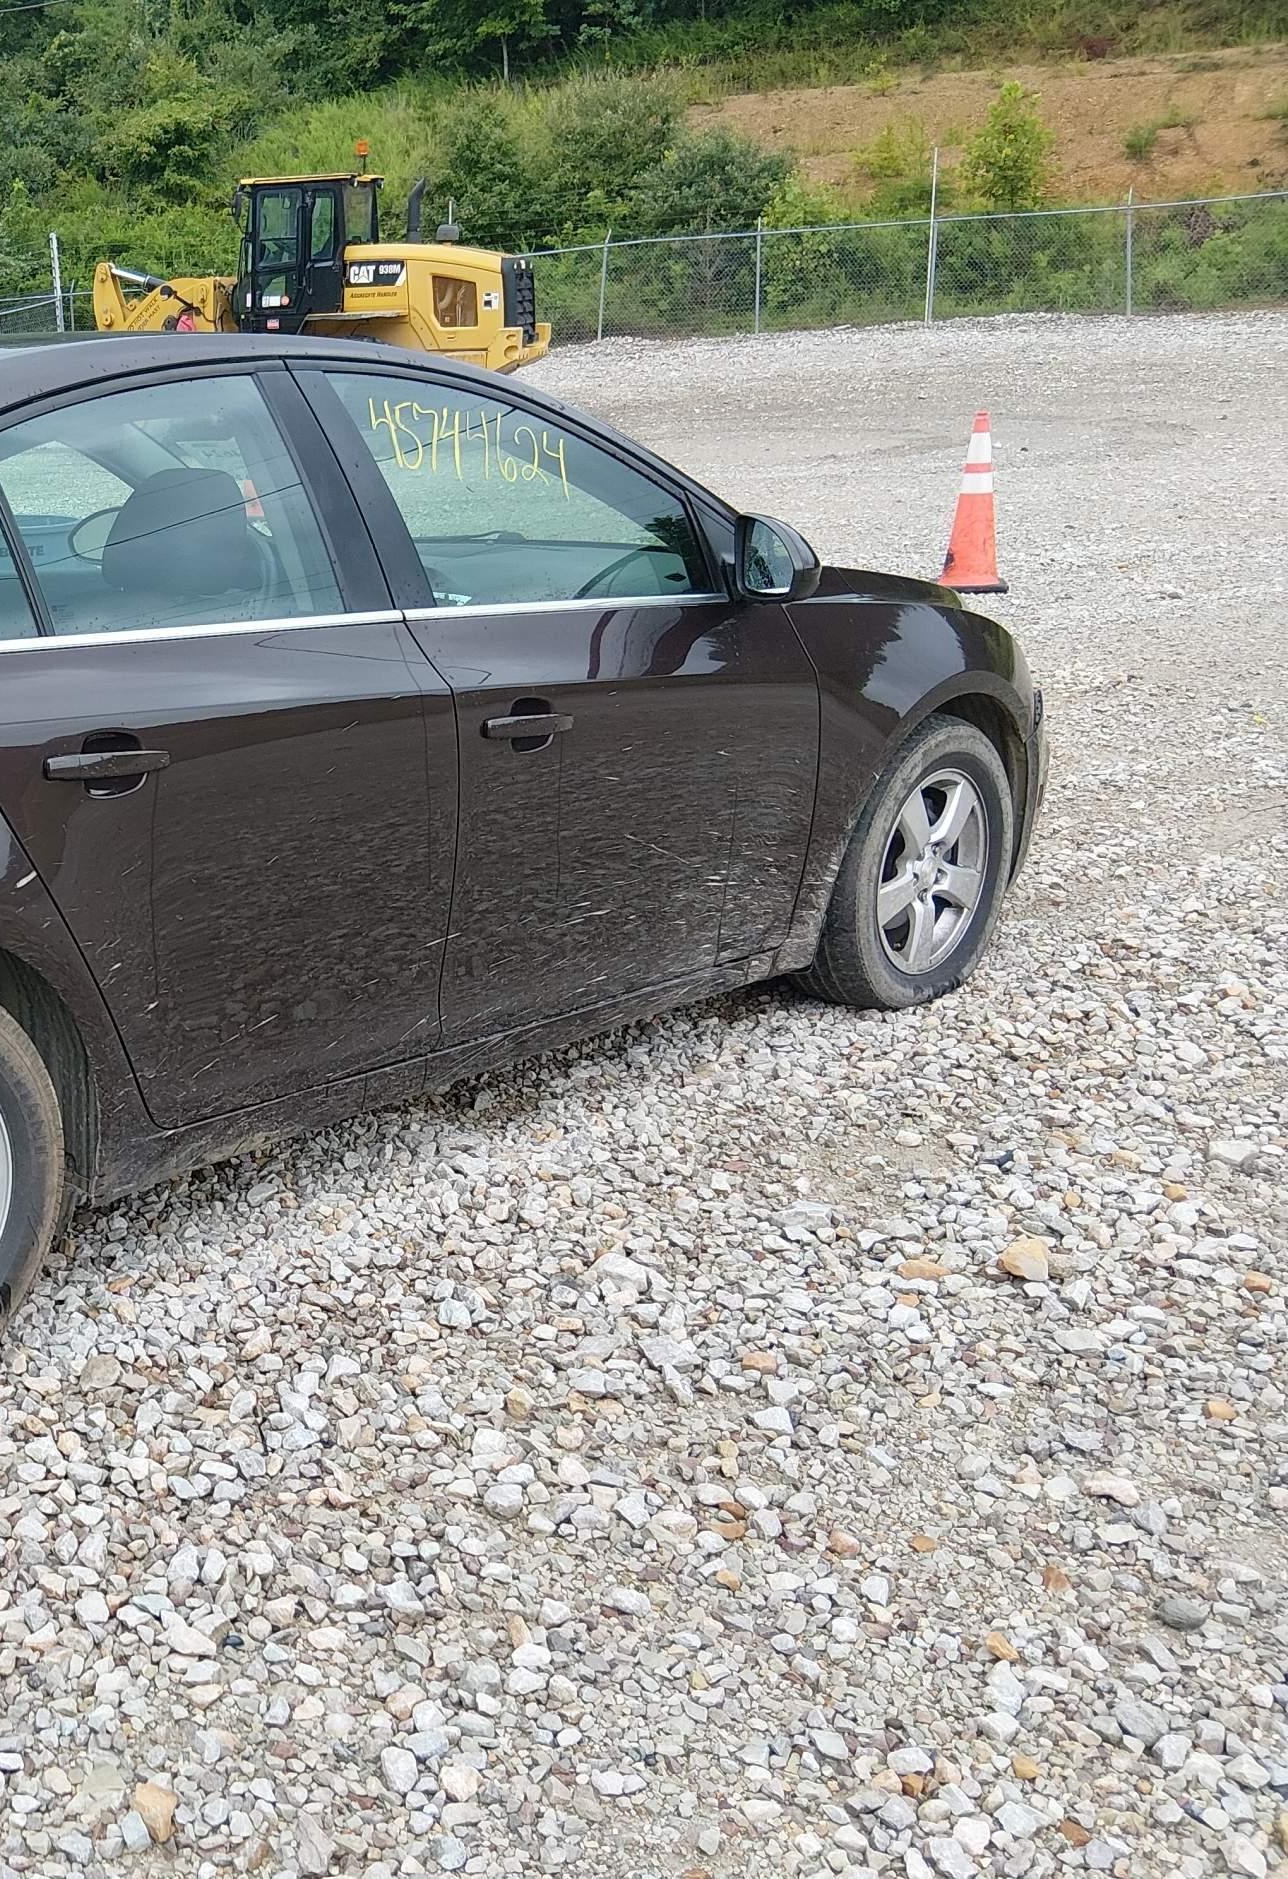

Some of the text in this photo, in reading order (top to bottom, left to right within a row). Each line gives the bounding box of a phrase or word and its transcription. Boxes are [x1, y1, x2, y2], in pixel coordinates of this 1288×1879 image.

[350, 264, 401, 284] CAT 938M
[368, 398, 569, 500] 45744624
[0, 545, 44, 557] BTE
